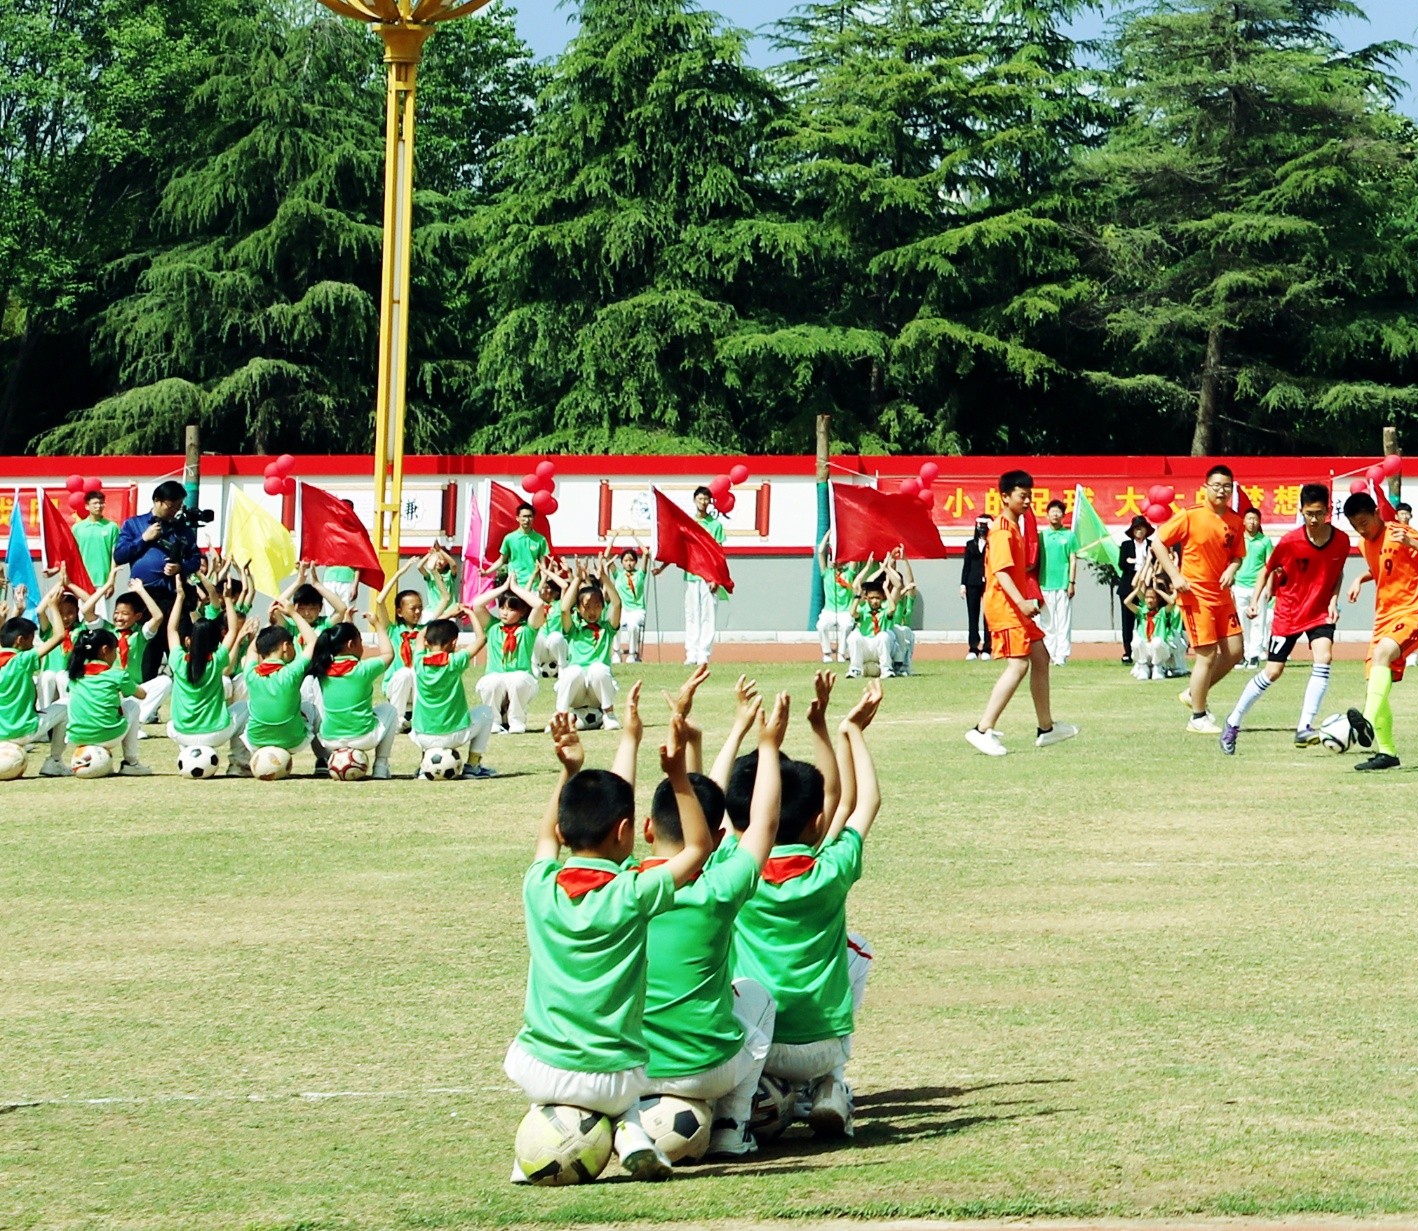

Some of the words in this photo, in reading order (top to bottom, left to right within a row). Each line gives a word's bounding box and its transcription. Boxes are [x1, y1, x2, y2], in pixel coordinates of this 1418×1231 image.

[1384, 558, 1393, 576] 9
[1392, 622, 1405, 633] 9
[1269, 635, 1287, 655] 17
